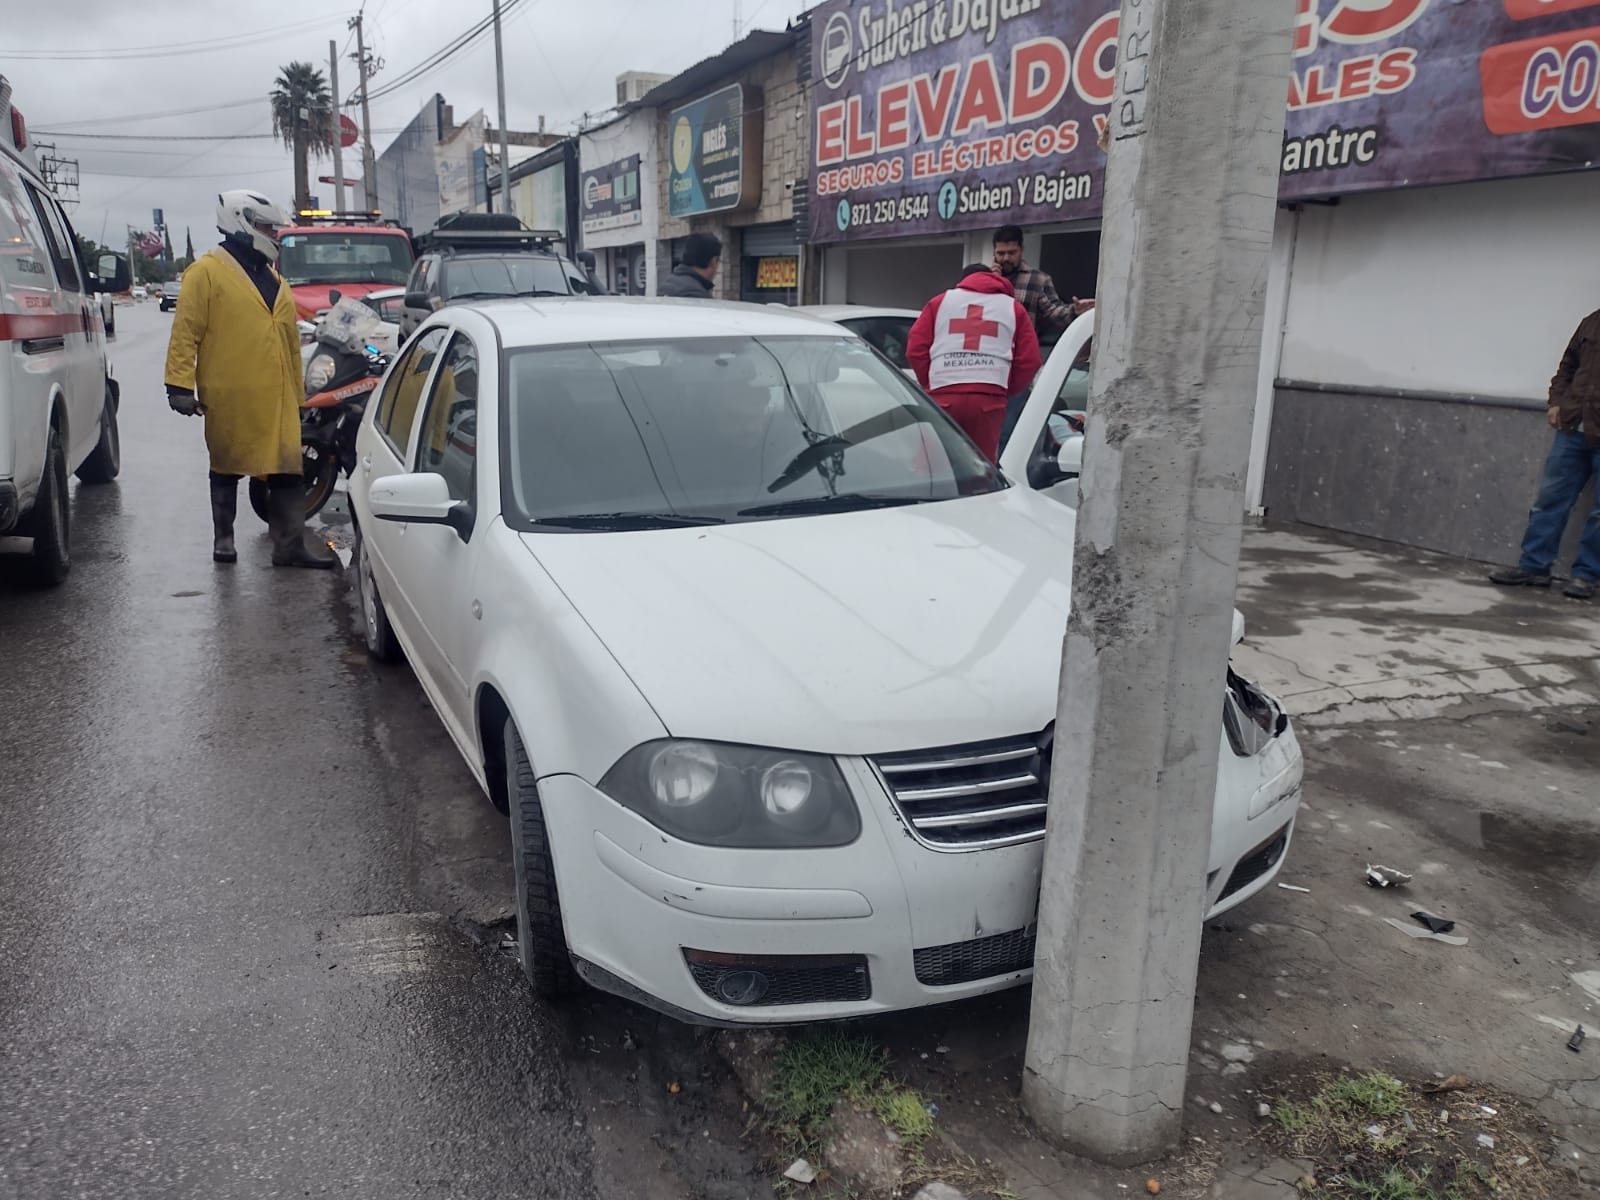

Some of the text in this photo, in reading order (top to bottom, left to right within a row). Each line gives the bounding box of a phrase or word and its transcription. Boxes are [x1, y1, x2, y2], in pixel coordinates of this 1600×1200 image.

[857, 0, 927, 72] Suben
[1521, 40, 1600, 118] CO
[817, 158, 903, 194] SEGUROS
[912, 120, 1079, 179] ELÉCTRICOS
[852, 170, 1091, 226] 871 250 4544 Suben Y Bajan
[943, 359, 994, 368] MEXICANA
